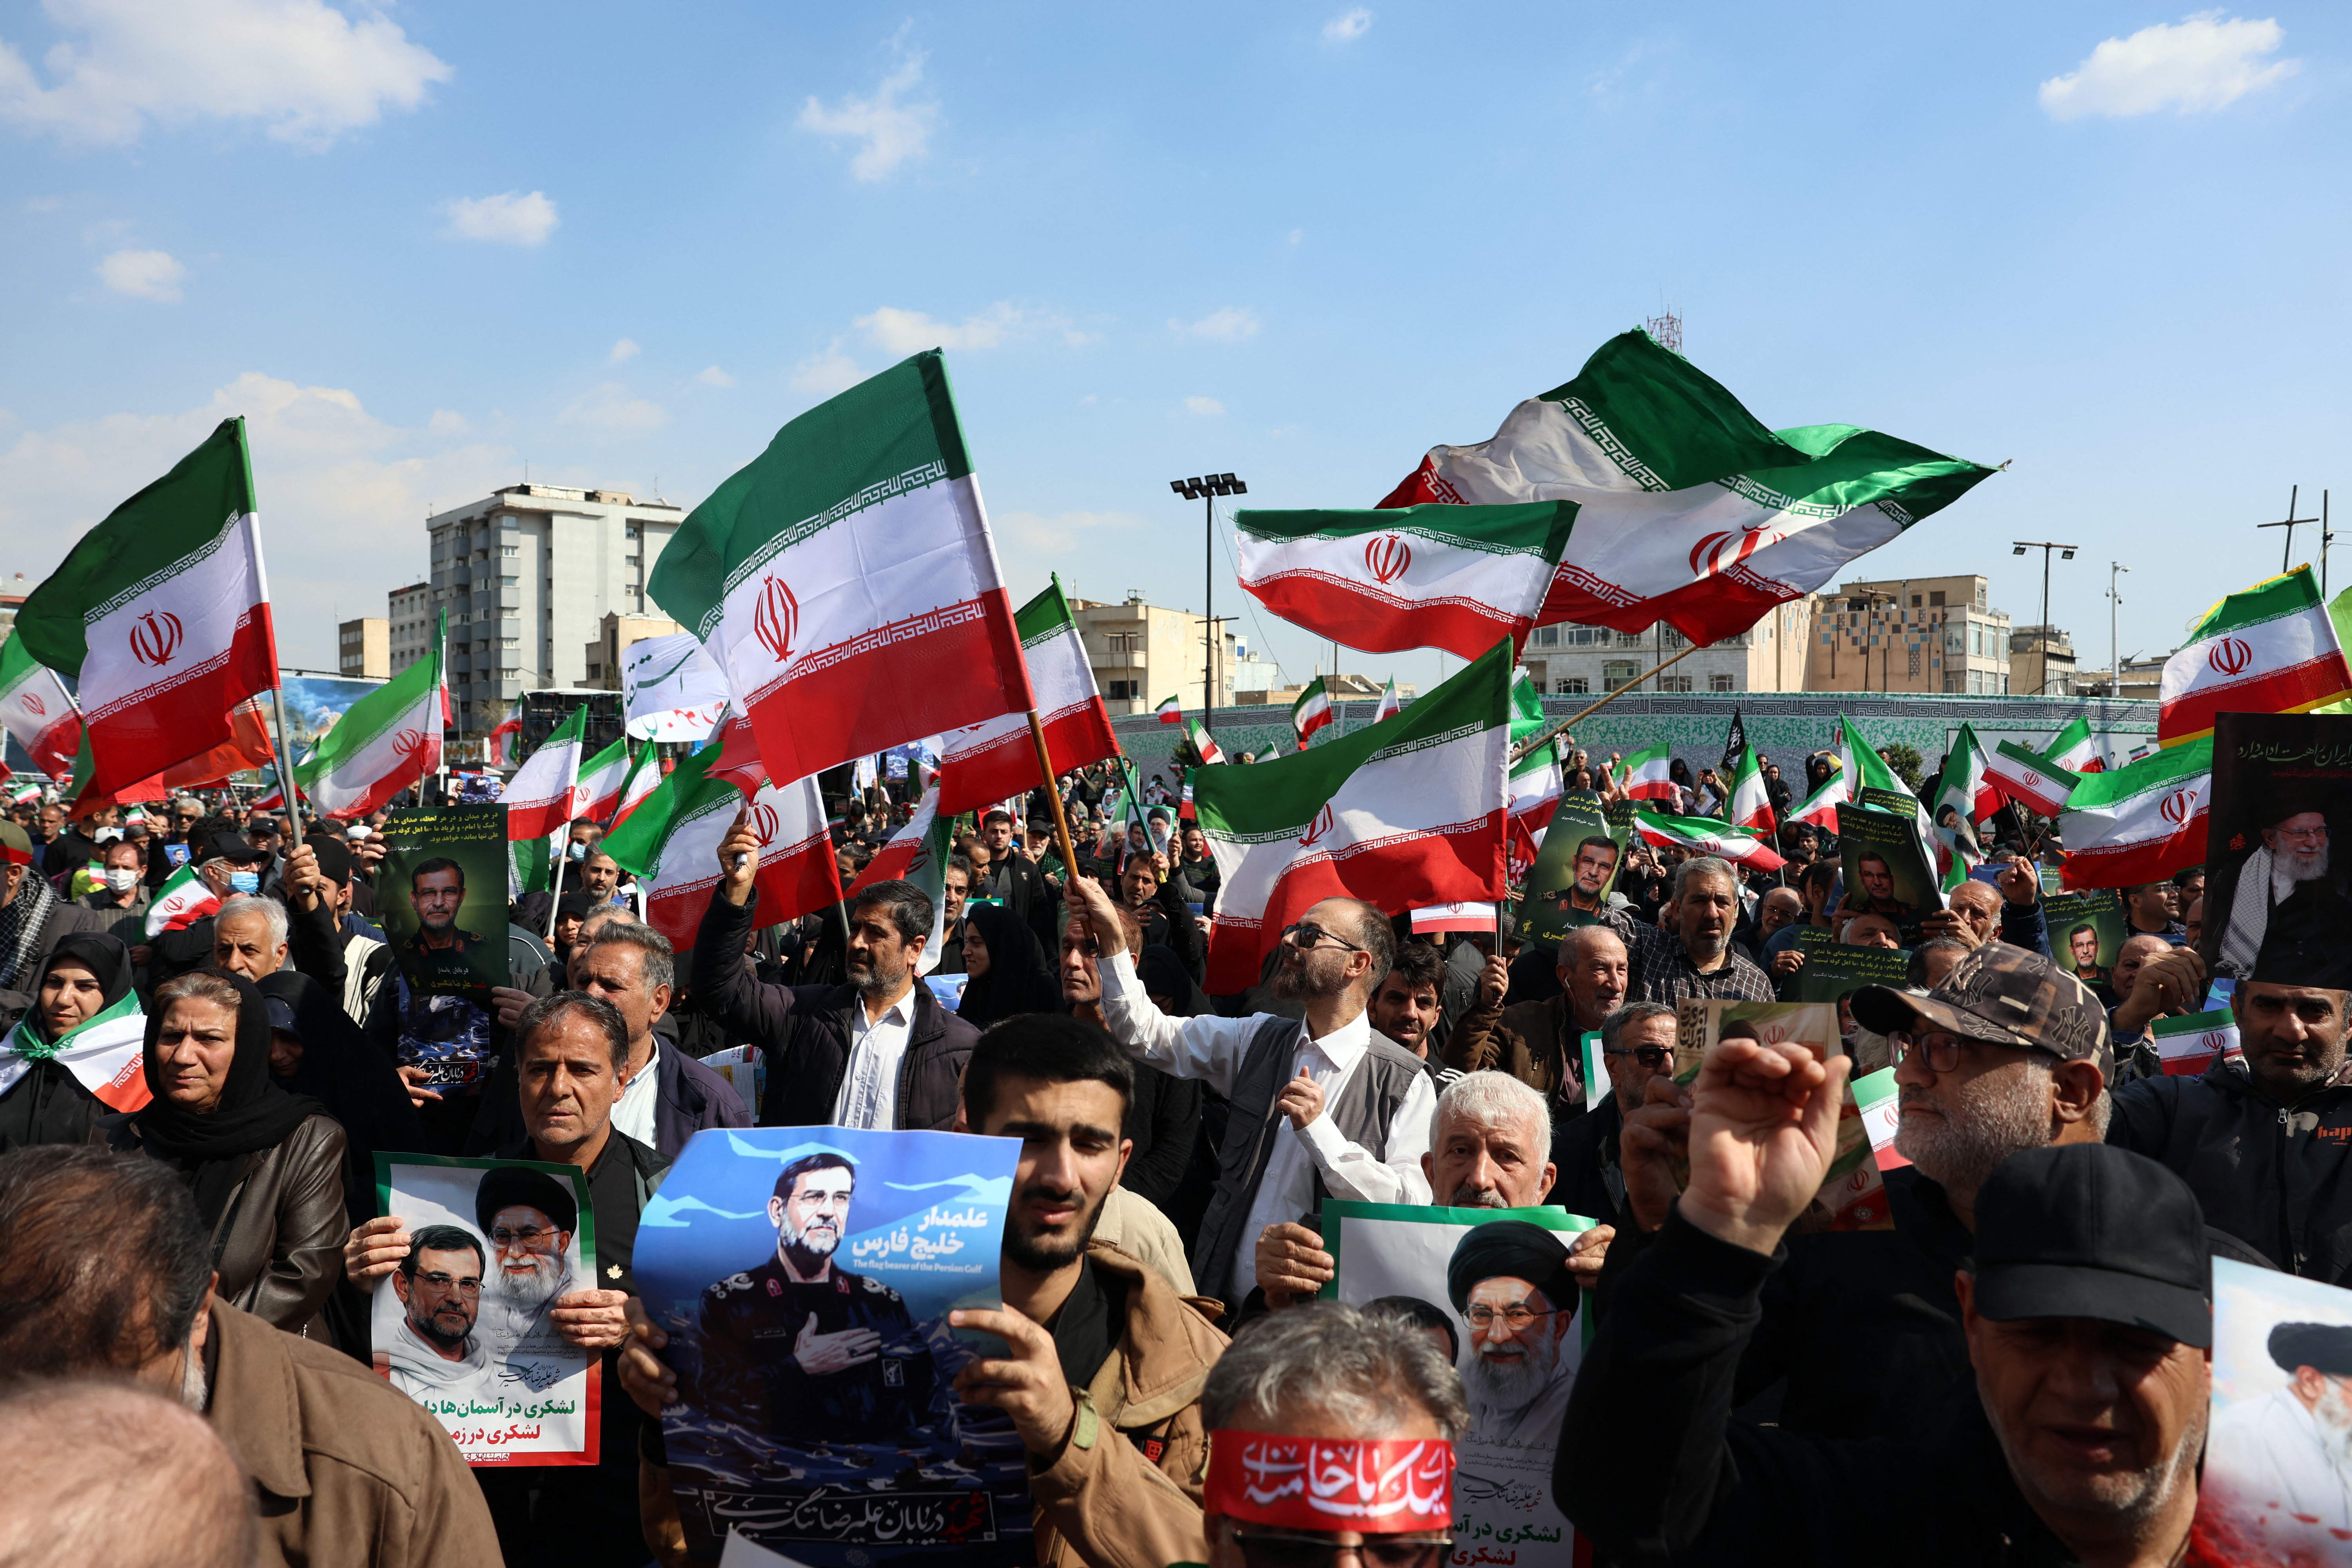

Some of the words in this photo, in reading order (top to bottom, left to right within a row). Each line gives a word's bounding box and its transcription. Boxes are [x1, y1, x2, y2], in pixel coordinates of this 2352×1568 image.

[453, 980, 471, 989] علیرضا
[473, 980, 486, 989] شهید
[441, 1065, 464, 1084] دریابان
[462, 1061, 477, 1083] شهید
[918, 1206, 988, 1232] علمدار
[852, 1226, 909, 1258] فارس
[910, 1231, 964, 1260] خلیج
[853, 1259, 867, 1268] The
[869, 1259, 884, 1270] flag
[884, 1260, 910, 1271] bearer
[911, 1261, 920, 1270] of
[920, 1261, 934, 1271] the
[935, 1263, 964, 1272] Persian
[964, 1264, 983, 1274] Gulf
[497, 1361, 539, 1388] تنگسیری
[531, 1370, 552, 1388] علیرضا
[544, 1368, 560, 1389] شهید
[505, 1402, 522, 1418] در
[524, 1399, 575, 1418] لشکری
[467, 1428, 484, 1445] در
[487, 1424, 540, 1445] لشکری
[1463, 1479, 1515, 1503] تنگسیری
[1506, 1490, 1532, 1510] علیرضا
[1523, 1490, 1542, 1512] شهید
[820, 1499, 885, 1544] علیرضا
[875, 1501, 945, 1546] دریابان
[940, 1490, 987, 1544] شهید
[1472, 1523, 1492, 1539] در
[1495, 1524, 1561, 1544] لشکری
[1451, 1547, 1515, 1567] لشکری
